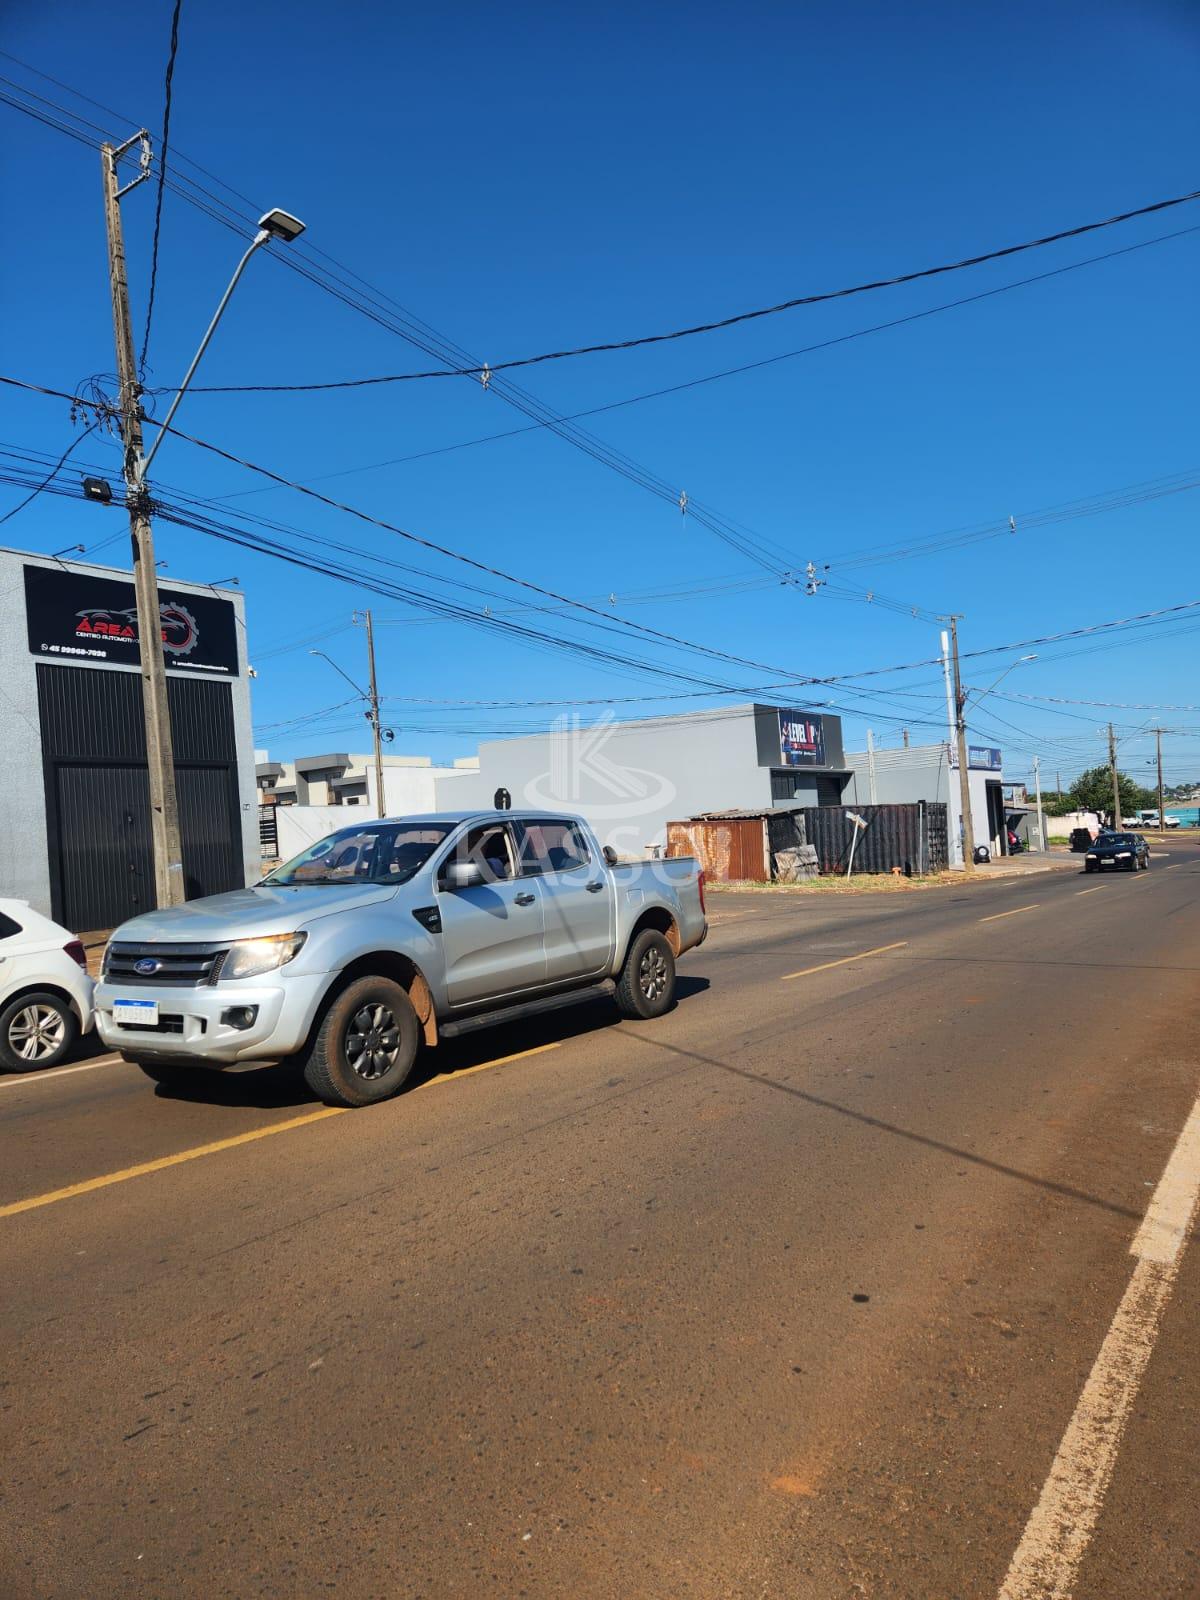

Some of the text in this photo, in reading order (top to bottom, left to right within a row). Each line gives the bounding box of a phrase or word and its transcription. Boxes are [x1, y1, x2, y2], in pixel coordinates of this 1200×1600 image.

[75, 617, 135, 637] ÁREA
[788, 722, 807, 743] LEVEL
[138, 961, 153, 970] Ford
